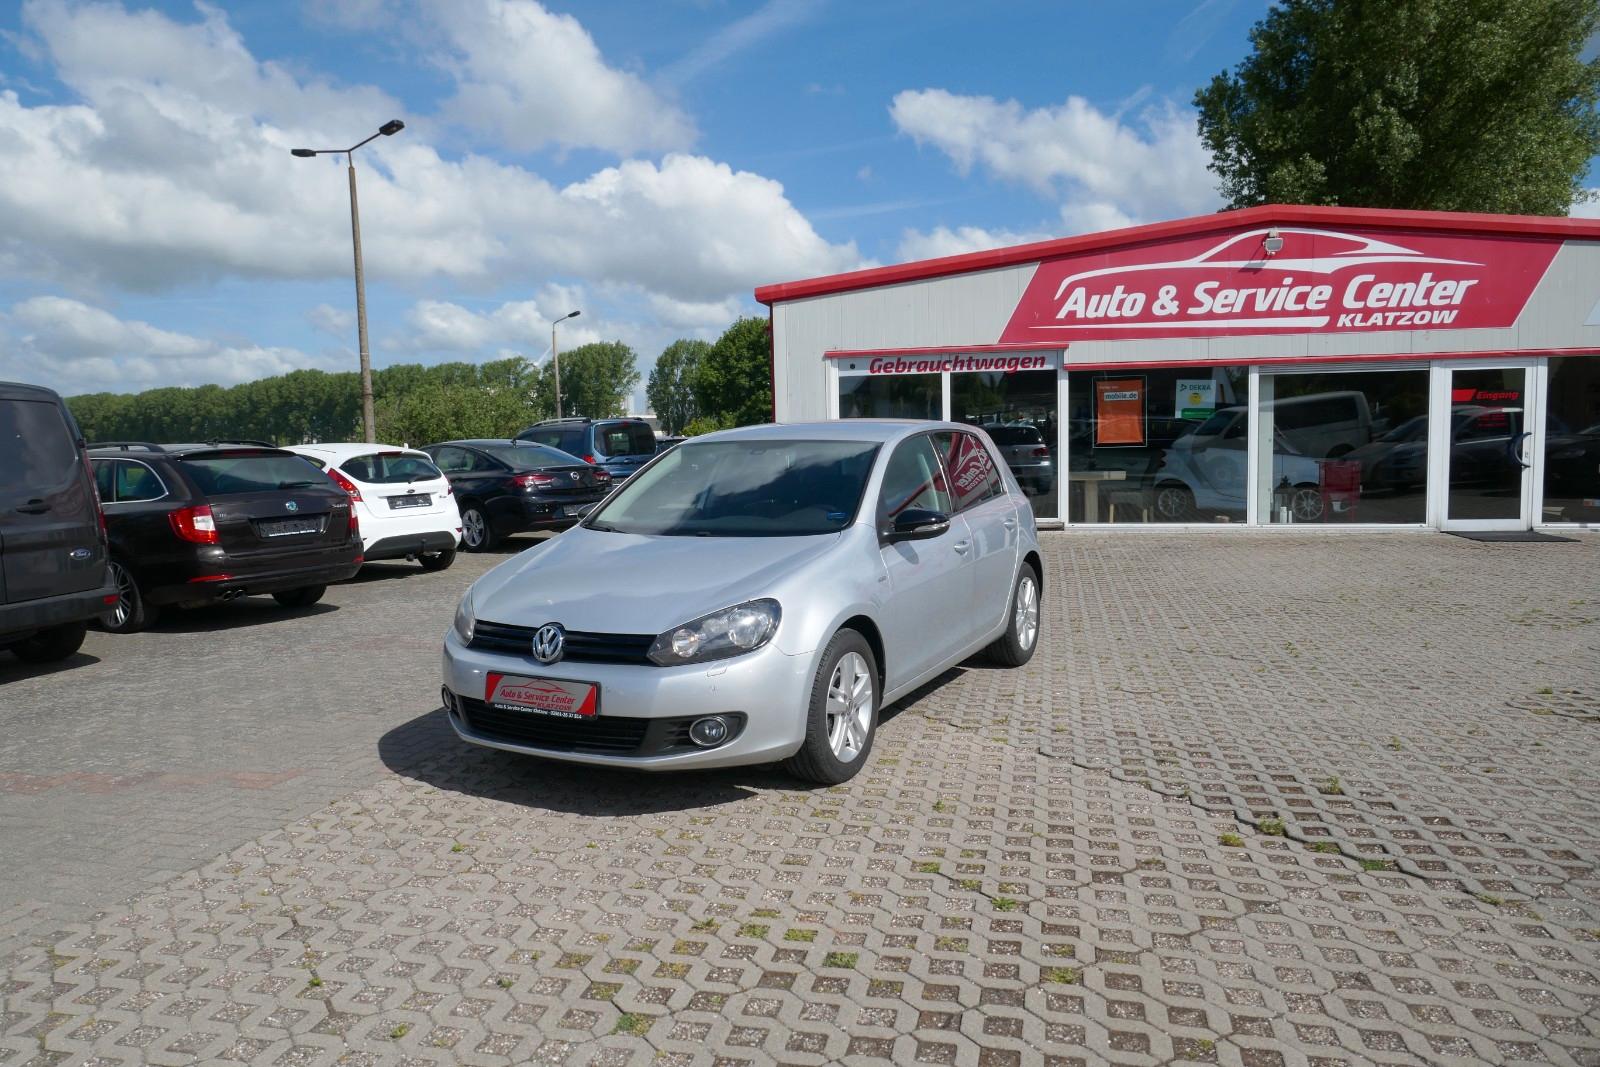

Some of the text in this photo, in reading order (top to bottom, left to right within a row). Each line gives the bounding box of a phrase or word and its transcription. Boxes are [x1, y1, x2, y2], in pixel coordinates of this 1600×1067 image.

[1055, 272, 1479, 319] Auto & Service Center
[1336, 309, 1458, 328] KLATZOW
[869, 355, 1046, 374] Gebrauchtwagen
[1105, 391, 1137, 400] mobile.de
[1476, 391, 1519, 400] Eingang
[500, 688, 516, 699] Auto
[525, 691, 550, 702] Service
[551, 694, 577, 704] Center
